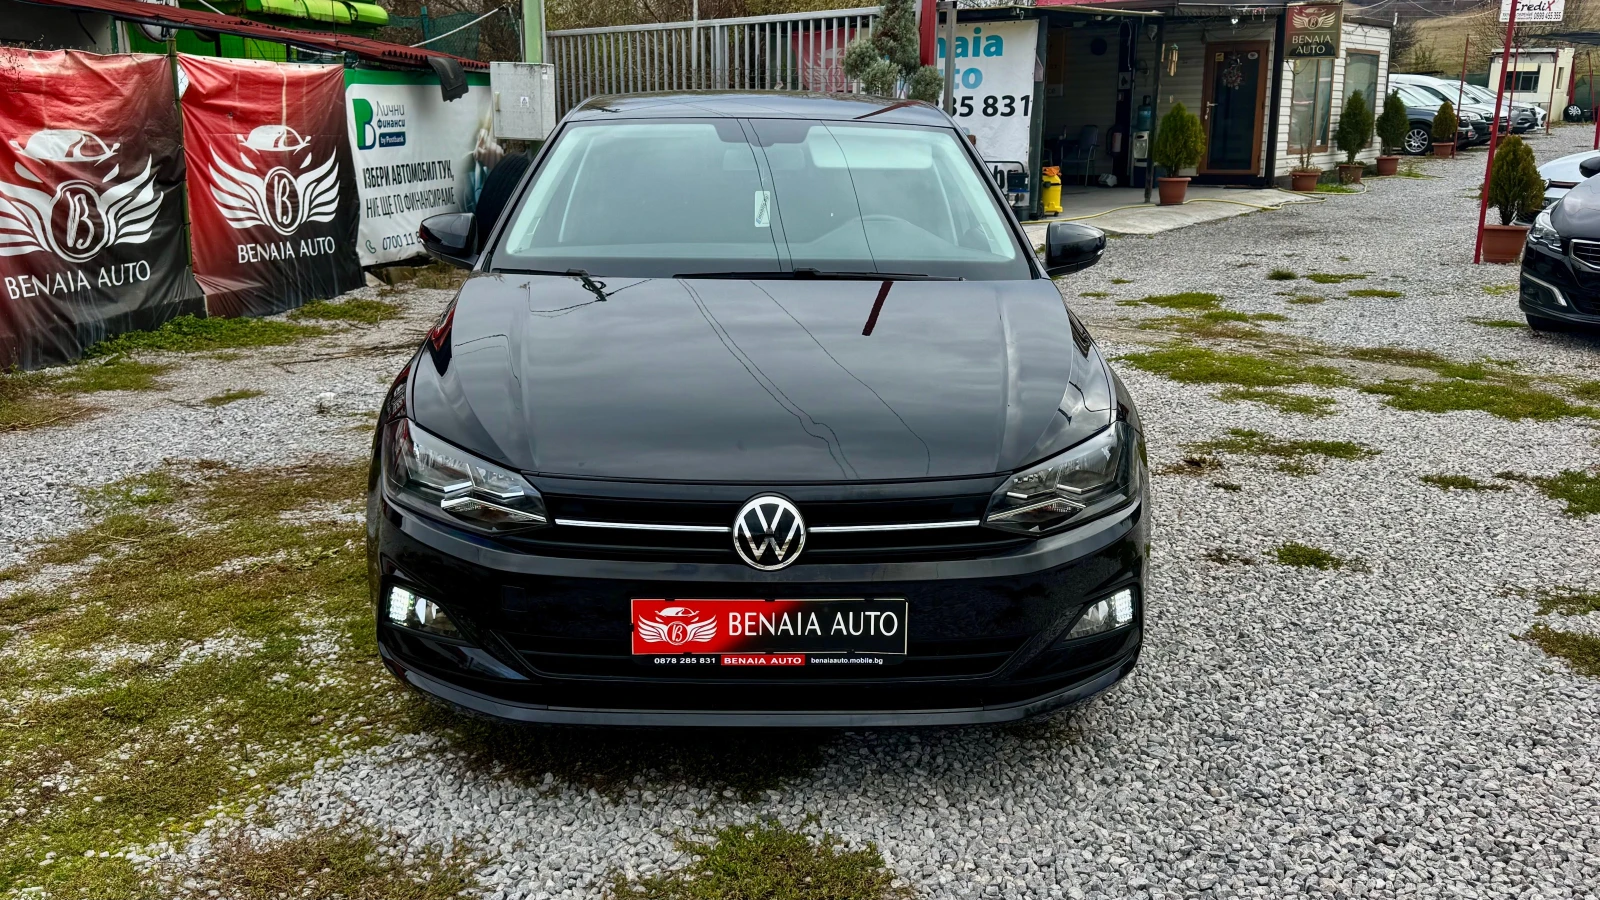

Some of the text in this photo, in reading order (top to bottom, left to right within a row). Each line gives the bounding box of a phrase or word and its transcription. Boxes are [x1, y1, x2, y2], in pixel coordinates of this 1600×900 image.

[1292, 35, 1331, 44] BENAIA
[1296, 45, 1325, 54] AUTO
[376, 101, 405, 117] Лични
[982, 95, 1030, 117] 831
[380, 137, 386, 145] by
[391, 160, 438, 186] АВТОМОБИЛ
[437, 160, 454, 182] ТУК,
[380, 195, 394, 219] ЩЕ
[393, 194, 404, 214] ГО
[403, 187, 455, 212] ФИНАНСИРАМЕ
[238, 236, 336, 264] BENAIA AUTO
[382, 234, 403, 250] 0700
[403, 232, 415, 246] 11
[5, 260, 151, 300] BENAIA AUTO
[728, 611, 898, 636] BENAIA AUTO
[654, 657, 677, 665] 0878
[724, 657, 767, 665] BENAIA
[770, 656, 802, 664] AUTO
[811, 657, 883, 665] benaiaauto.mobile.bg
